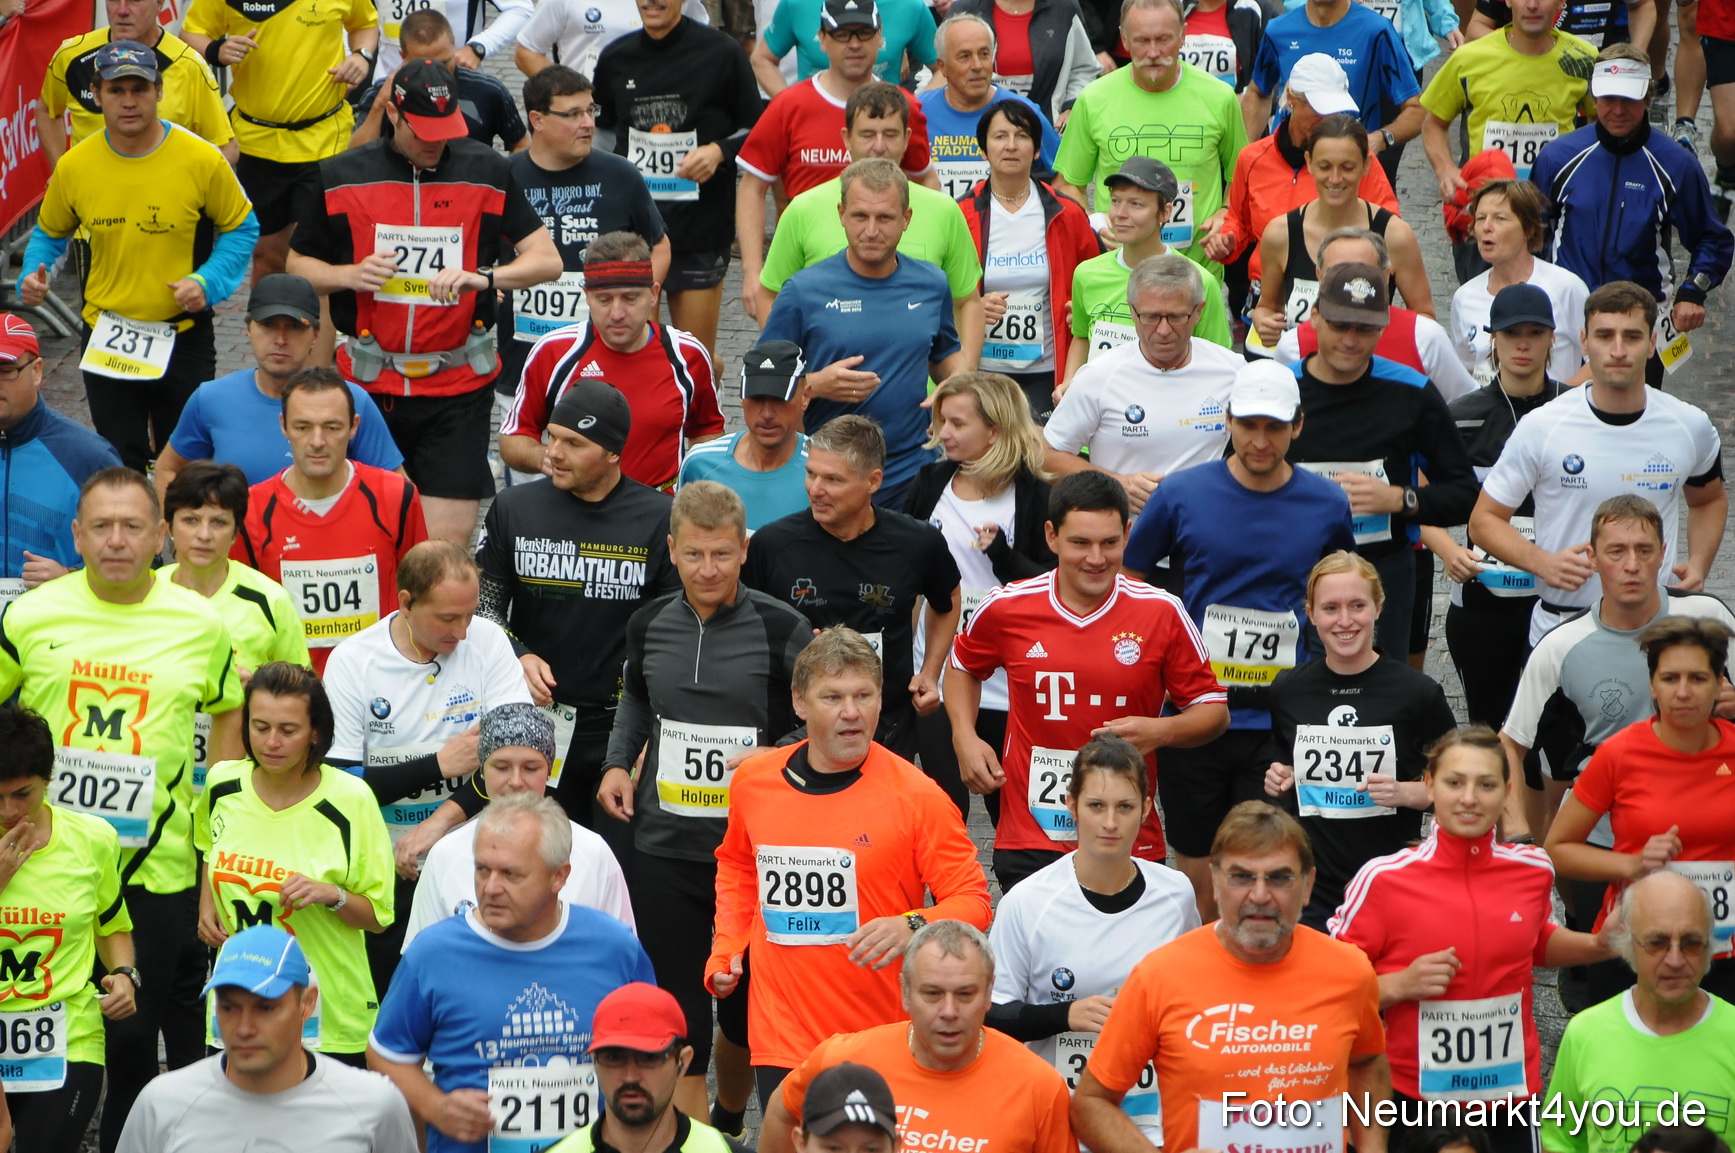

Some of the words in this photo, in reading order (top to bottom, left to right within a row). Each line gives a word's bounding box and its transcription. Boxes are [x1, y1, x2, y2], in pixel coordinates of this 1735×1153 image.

[243, 3, 275, 12] Robert
[1486, 128, 1510, 136] PARTL
[801, 148, 852, 163] NEUMA
[551, 186, 587, 201] MORRO
[92, 217, 126, 226] Jürgen
[561, 215, 598, 229] Sur
[377, 232, 405, 241] PARTL
[407, 235, 447, 243] Neumarkt
[394, 245, 445, 274] 274
[988, 251, 1045, 267] heinloth
[1295, 286, 1315, 296] PARTL
[520, 289, 582, 318] 2097
[1094, 328, 1119, 340] PARTL
[105, 325, 153, 359] 231
[992, 346, 1015, 359] Inge
[104, 357, 140, 374] Jürgen
[1122, 425, 1149, 433] PARTL
[1561, 476, 1588, 484] PARTL
[580, 542, 624, 553] HAMBURG
[627, 547, 648, 555] 2012
[283, 569, 313, 578] PARTL
[316, 567, 361, 577] Neumarkt
[514, 552, 646, 586] URBANATHLON
[1503, 575, 1530, 587] Nina
[302, 580, 361, 614] 504
[584, 582, 593, 598] &
[595, 583, 641, 600] FESTIVAL
[305, 619, 362, 636] Bernhard
[1207, 610, 1236, 622] PARTL
[1242, 615, 1285, 630] Neumarkt
[1224, 629, 1281, 661] 179
[72, 659, 153, 684] Müller
[1223, 664, 1269, 681] Marcus
[83, 705, 126, 740] M
[369, 721, 395, 729] PARTL
[662, 729, 688, 742] PARTL
[690, 734, 738, 745] Neumarkt
[1297, 735, 1328, 744] PARTL
[1329, 736, 1376, 745] Neumarkt
[55, 755, 84, 768] PARTL
[86, 759, 136, 775] Neumarkt
[369, 755, 401, 764] PARTL
[684, 747, 724, 782] 56
[1034, 756, 1065, 768] PARTL
[1304, 749, 1386, 783] 2347
[58, 771, 144, 812] 2027
[681, 789, 725, 807] Holger
[1325, 792, 1366, 806] Nicole
[757, 854, 787, 866] PARTL
[788, 855, 836, 867] Neumarkt
[765, 870, 847, 907] 2898
[0, 906, 66, 925] üller
[788, 916, 821, 931] Felix
[1050, 991, 1078, 1001] PARTL
[1421, 1011, 1458, 1023] PARTL
[1461, 1007, 1507, 1021] Neumarkt
[1210, 1019, 1318, 1043] Fischer
[500, 1035, 560, 1049] Neumarkter
[1059, 1037, 1094, 1048] PARTL
[1220, 1042, 1312, 1055] AUTOMOBILE
[1430, 1022, 1515, 1064] 3017
[475, 1041, 506, 1059] 13.
[1238, 1065, 1261, 1078] und
[1264, 1063, 1287, 1075] das
[492, 1078, 529, 1090] PARTL
[531, 1078, 583, 1088] Neumarkt
[1267, 1078, 1301, 1092] fährt
[1451, 1068, 1498, 1091] Regina
[500, 1092, 590, 1133] 2119
